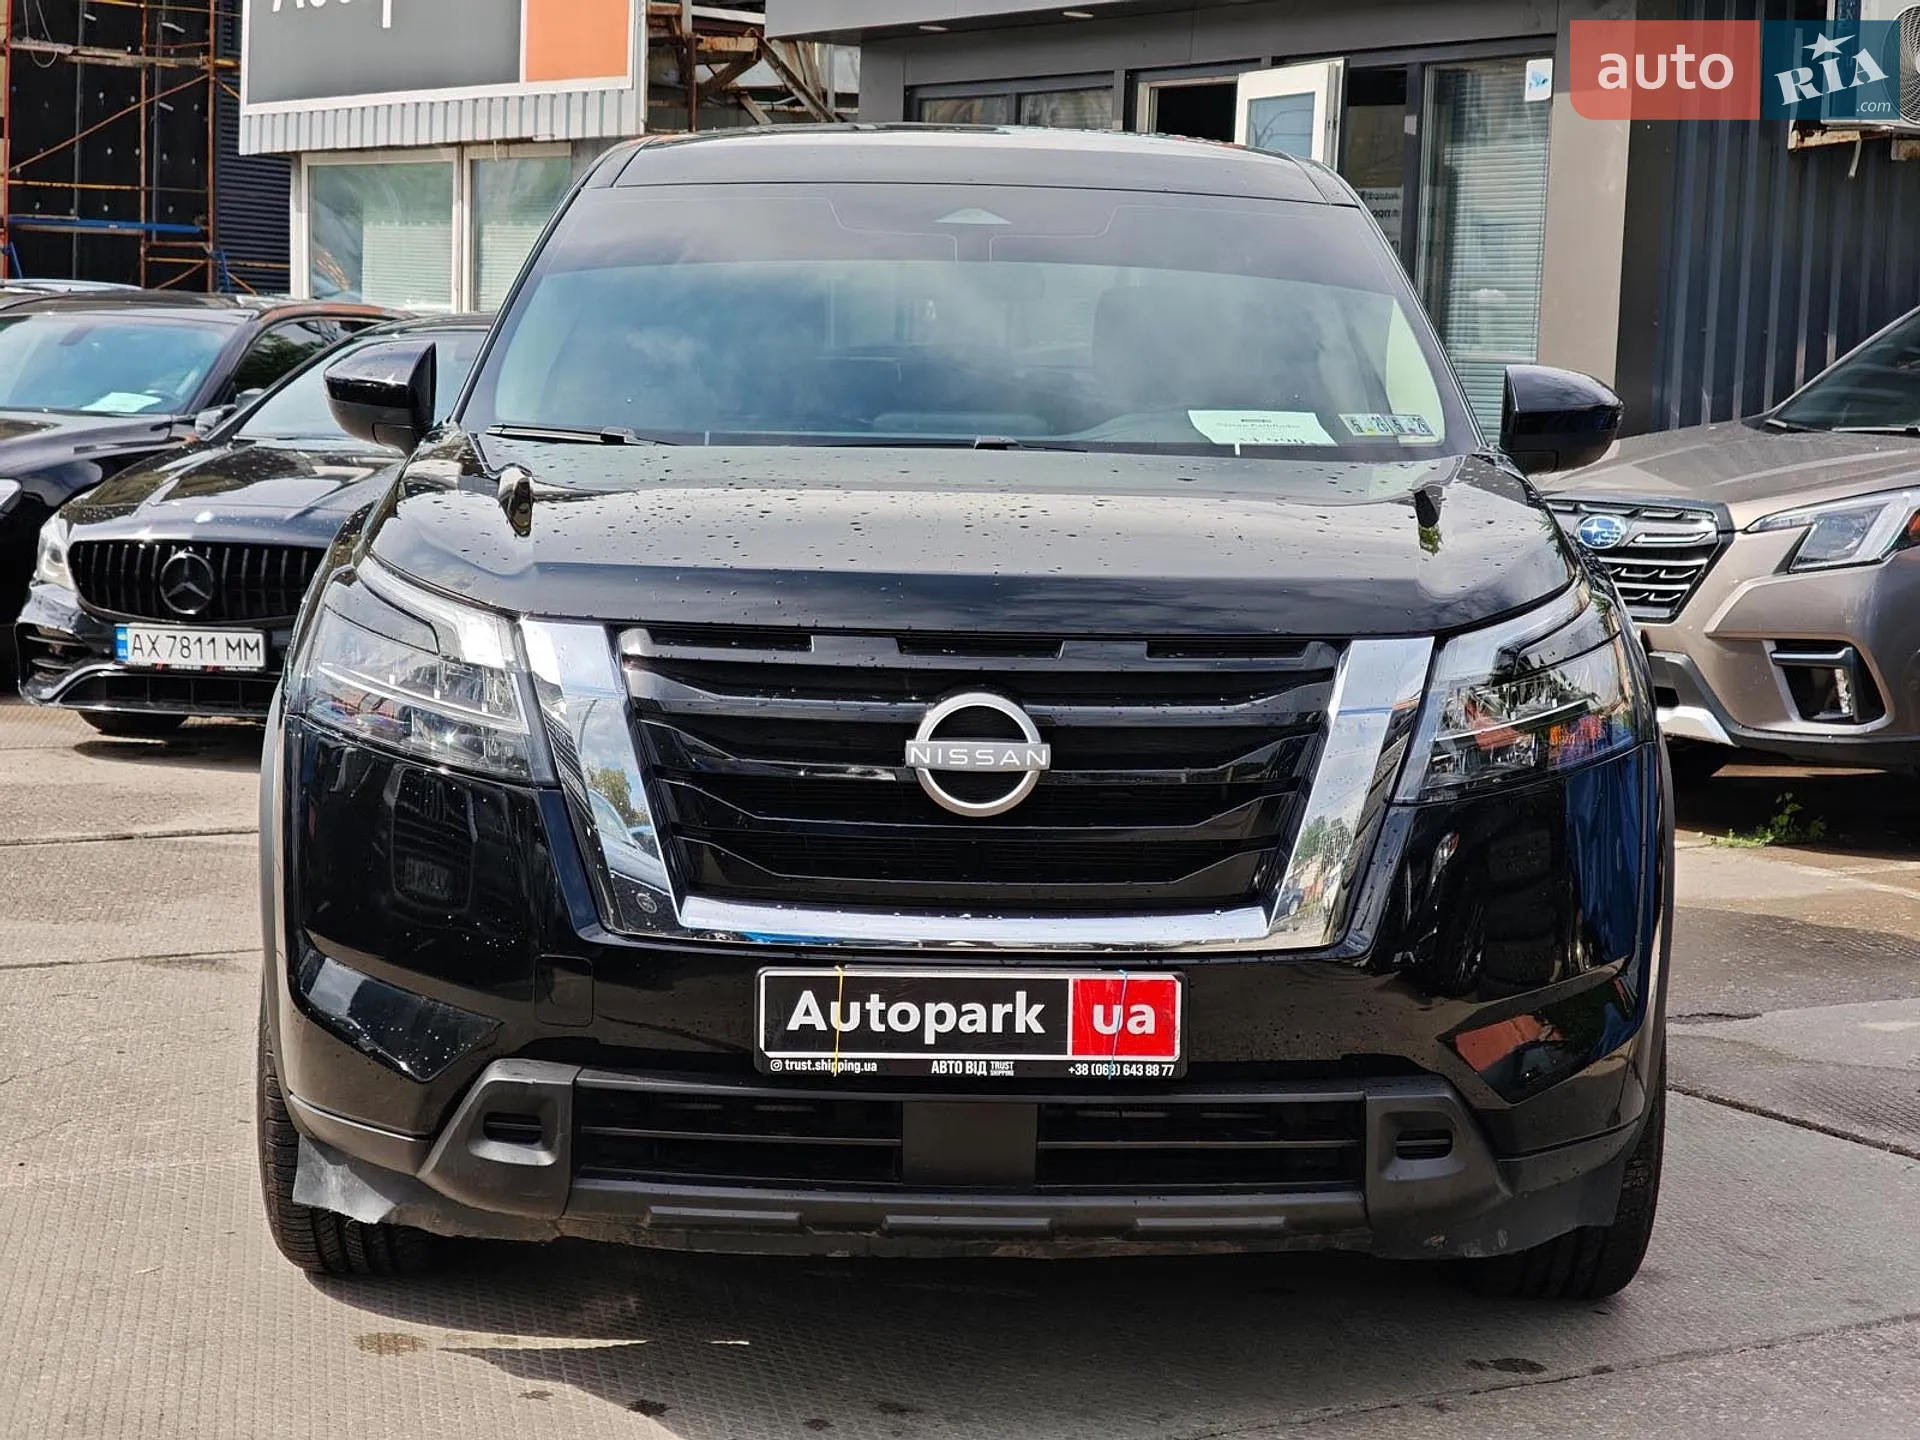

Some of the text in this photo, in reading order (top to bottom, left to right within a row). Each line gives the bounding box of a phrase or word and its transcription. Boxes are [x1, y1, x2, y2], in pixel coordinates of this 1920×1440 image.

[131, 634, 261, 661] AX 7811 MM
[909, 746, 1047, 766] NISSAN
[786, 990, 1156, 1045] Autopark ua
[785, 1059, 878, 1074] trust.shipping.ua
[931, 1060, 987, 1076] АВТО ВІД
[1068, 1063, 1089, 1076] +38
[1122, 1064, 1143, 1076] 643
[1145, 1064, 1159, 1076] 88
[1161, 1064, 1175, 1077] 77
